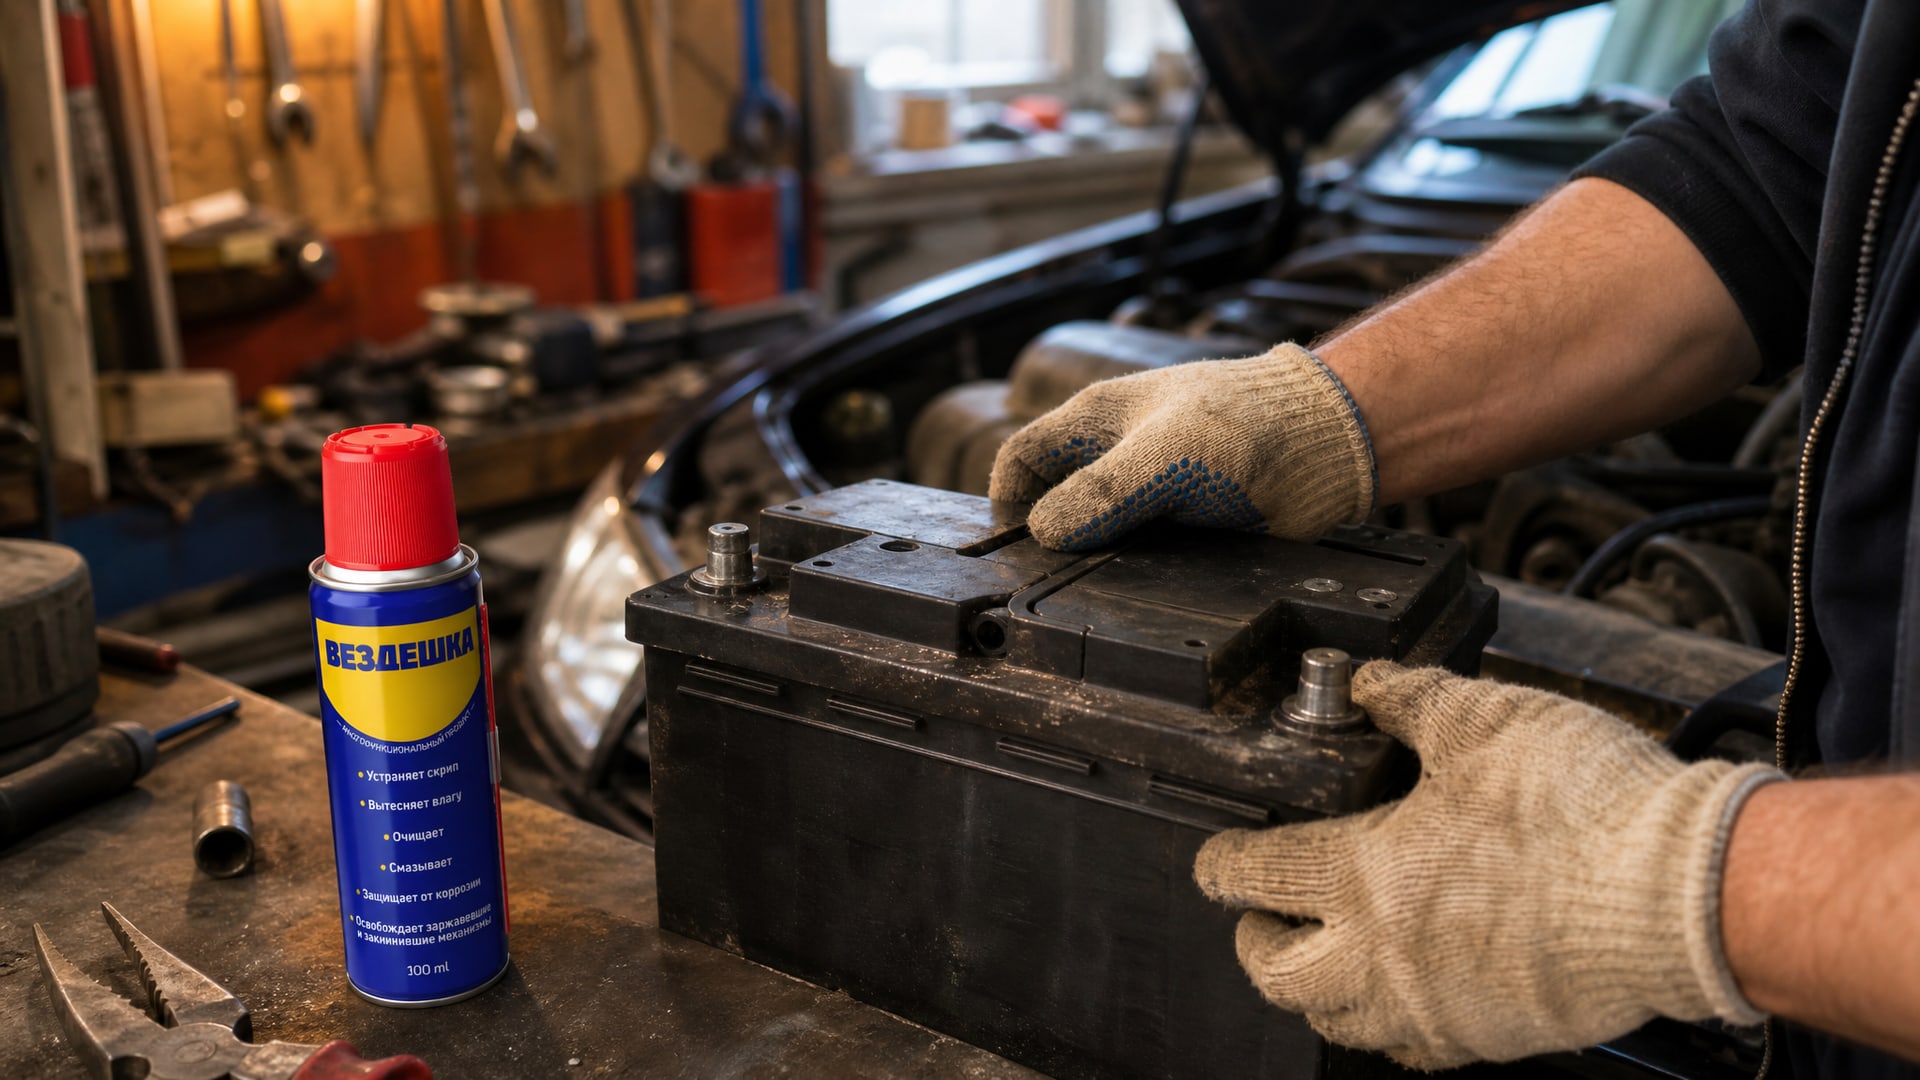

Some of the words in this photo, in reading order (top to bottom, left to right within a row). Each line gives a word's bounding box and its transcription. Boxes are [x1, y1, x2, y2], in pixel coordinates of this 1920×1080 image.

[325, 626, 474, 672] ВЕЗДЕШКА
[366, 770, 424, 784] Устраняет
[427, 762, 459, 777] скрип
[368, 799, 429, 811] Вытесняет
[432, 791, 462, 807] влагу
[392, 827, 444, 842] Очищает
[389, 857, 453, 873] Смазывает
[362, 889, 418, 904] Защищает
[421, 892, 432, 902] от
[435, 877, 481, 900] коррозии
[355, 915, 423, 935] Освобождает
[426, 903, 491, 932] заржавевшие
[357, 930, 363, 939] и
[438, 916, 492, 942] механизмы
[407, 964, 431, 976] 100
[434, 961, 450, 974] ml
